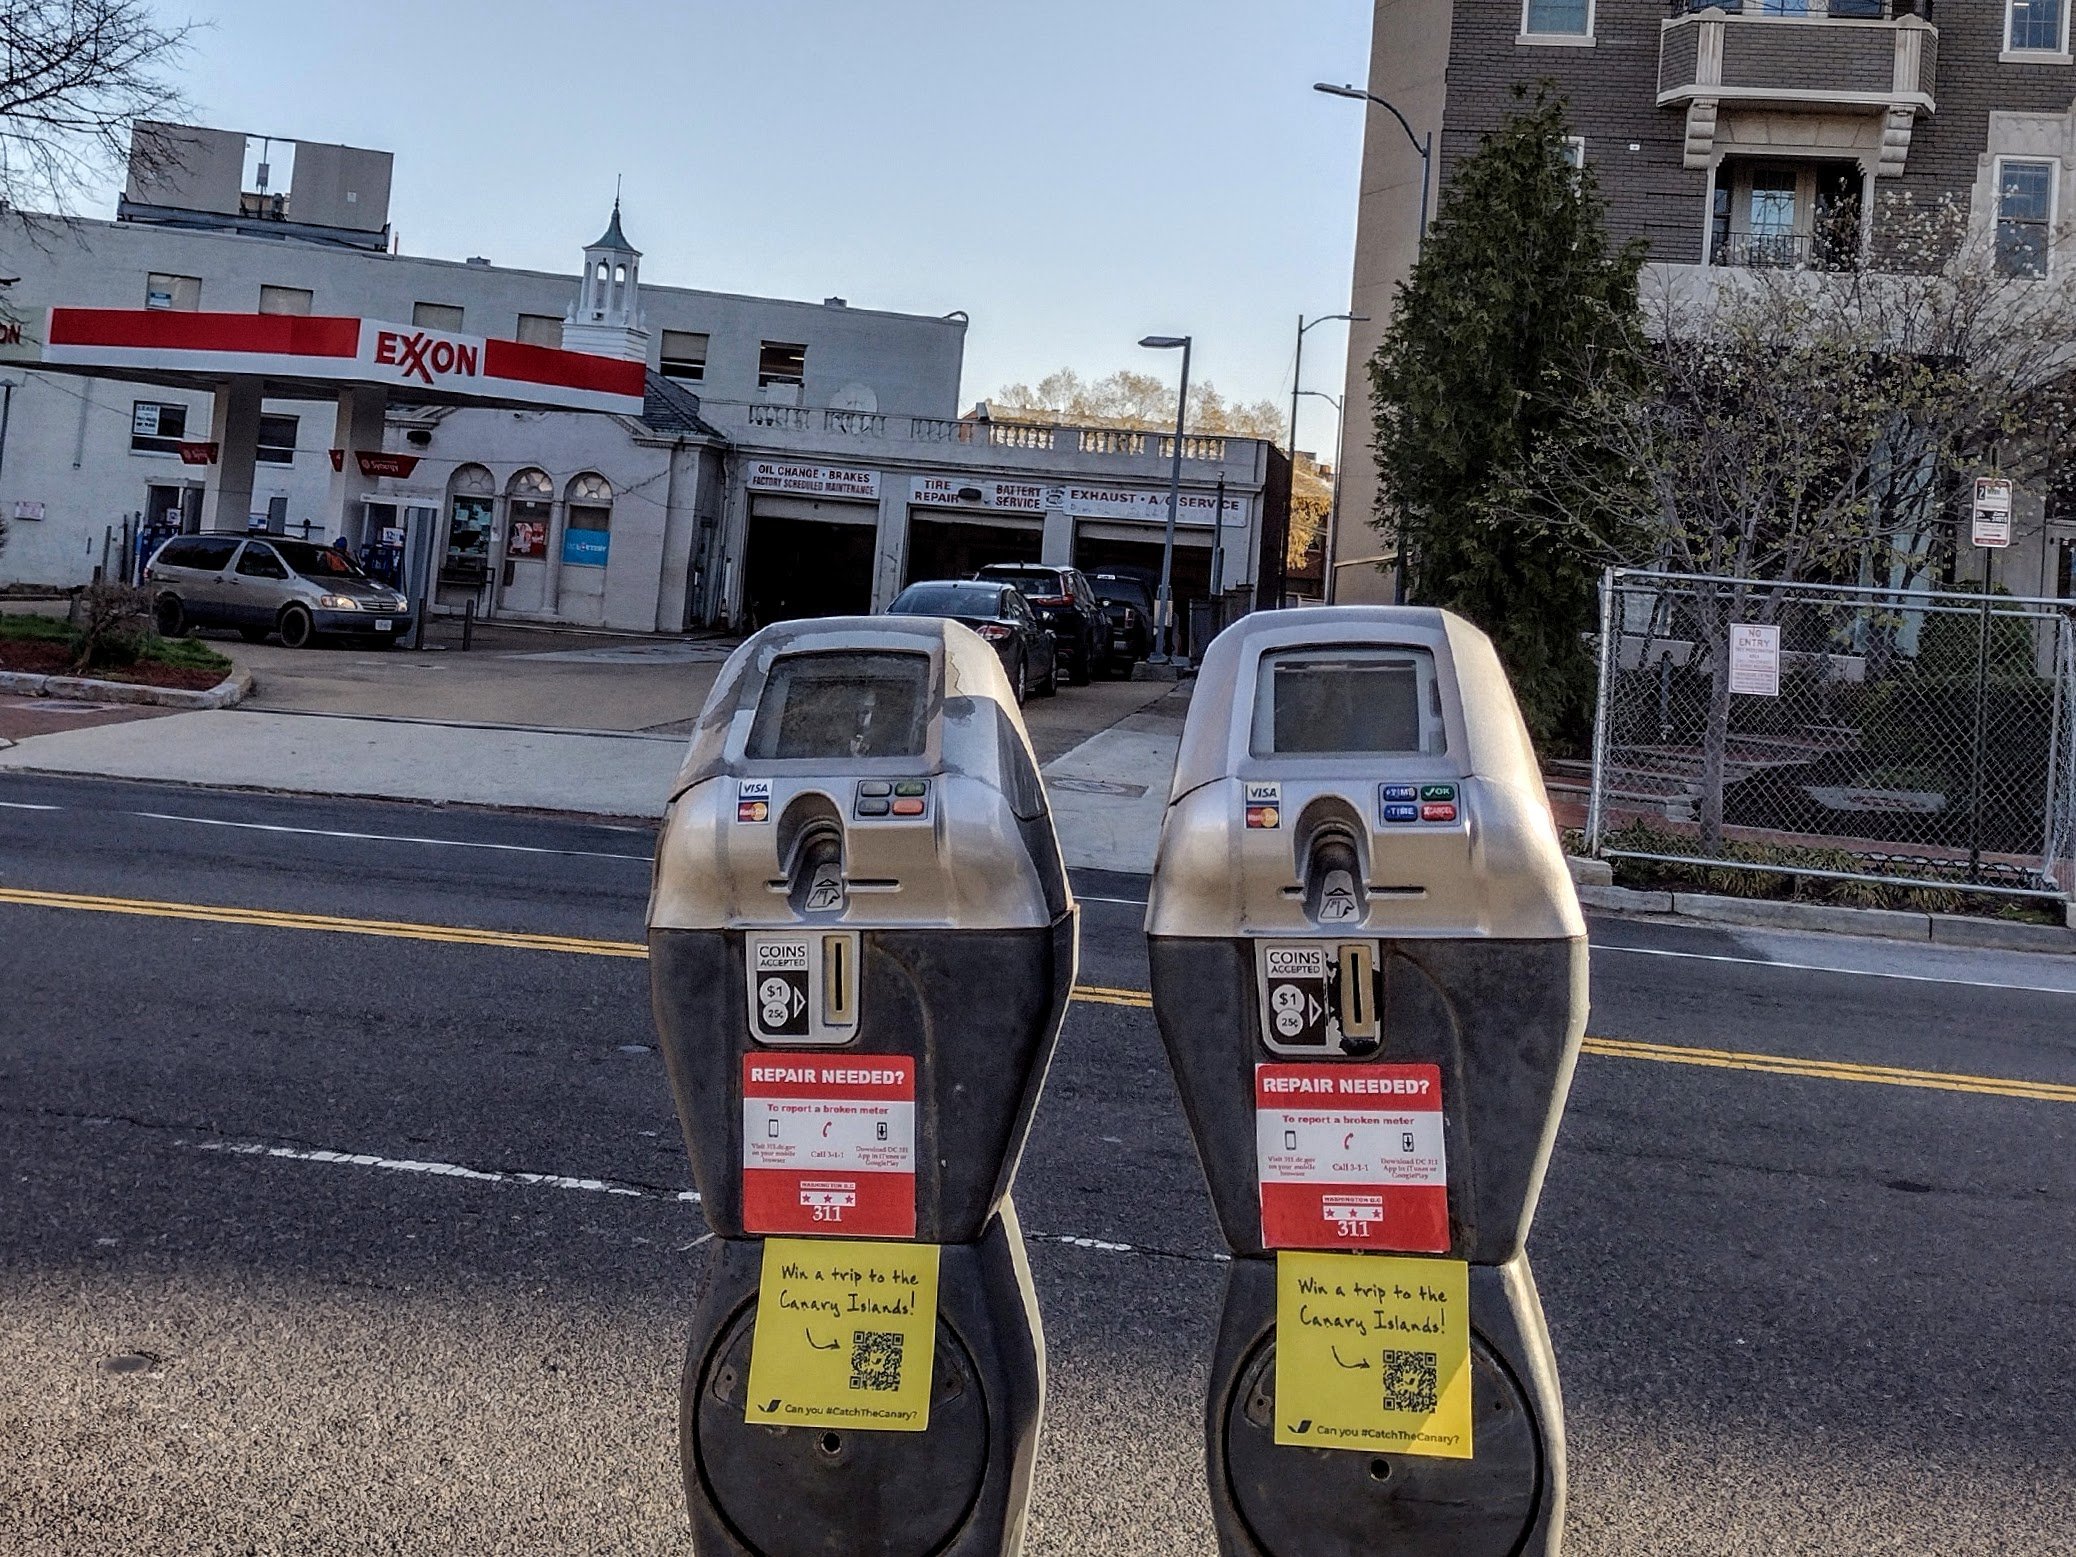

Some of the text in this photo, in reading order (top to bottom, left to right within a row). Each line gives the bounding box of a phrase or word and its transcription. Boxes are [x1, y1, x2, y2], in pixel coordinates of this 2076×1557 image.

[375, 332, 478, 385] EXXON
[758, 464, 871, 483] OIL CHANGE BRAKES
[752, 476, 875, 496] FACTORY SCHEDULED MAINTENANCE
[924, 479, 952, 490] TIRE
[996, 484, 1042, 498] BATTERY
[914, 491, 959, 504] REPAIR
[995, 496, 1041, 509] SERVICE
[1071, 489, 1137, 504] EXHAUST
[1179, 497, 1239, 511] SERVCE
[1748, 629, 1762, 638] NO
[1739, 638, 1770, 648] ENTRY
[744, 783, 768, 793] VISA
[1250, 787, 1277, 798] VISA
[760, 945, 806, 959] COINS
[1269, 951, 1320, 965] COINS
[760, 959, 806, 967] ACCEPTED
[1271, 965, 1321, 974] ACCEPTED
[766, 985, 782, 998] $1
[1279, 992, 1297, 1006] $1
[751, 1067, 905, 1085] REPAIR NEEDED?
[1263, 1078, 1430, 1095] REPAIR NEEDED?
[767, 1103, 779, 1112] To
[781, 1105, 812, 1115] report
[823, 1105, 857, 1114] broken
[859, 1107, 889, 1115] meter
[1282, 1115, 1295, 1123] To
[1298, 1115, 1330, 1125] report
[1343, 1116, 1380, 1125] broken
[1383, 1117, 1415, 1125] meter
[811, 1150, 844, 1159] Call 3-1-1
[1332, 1163, 1369, 1171] Call 3-1-1
[812, 1205, 842, 1222] 311
[1337, 1220, 1370, 1238] 311
[781, 1262, 919, 1287] Win a trip to the
[1297, 1276, 1448, 1305] Win a trip to the
[780, 1289, 915, 1318] Canary Islands!
[1300, 1304, 1446, 1337] Canary Islands!
[785, 1404, 918, 1421] Can you #CatchTheCanary?
[1316, 1425, 1460, 1446] Can you #CatchTheCanary?
